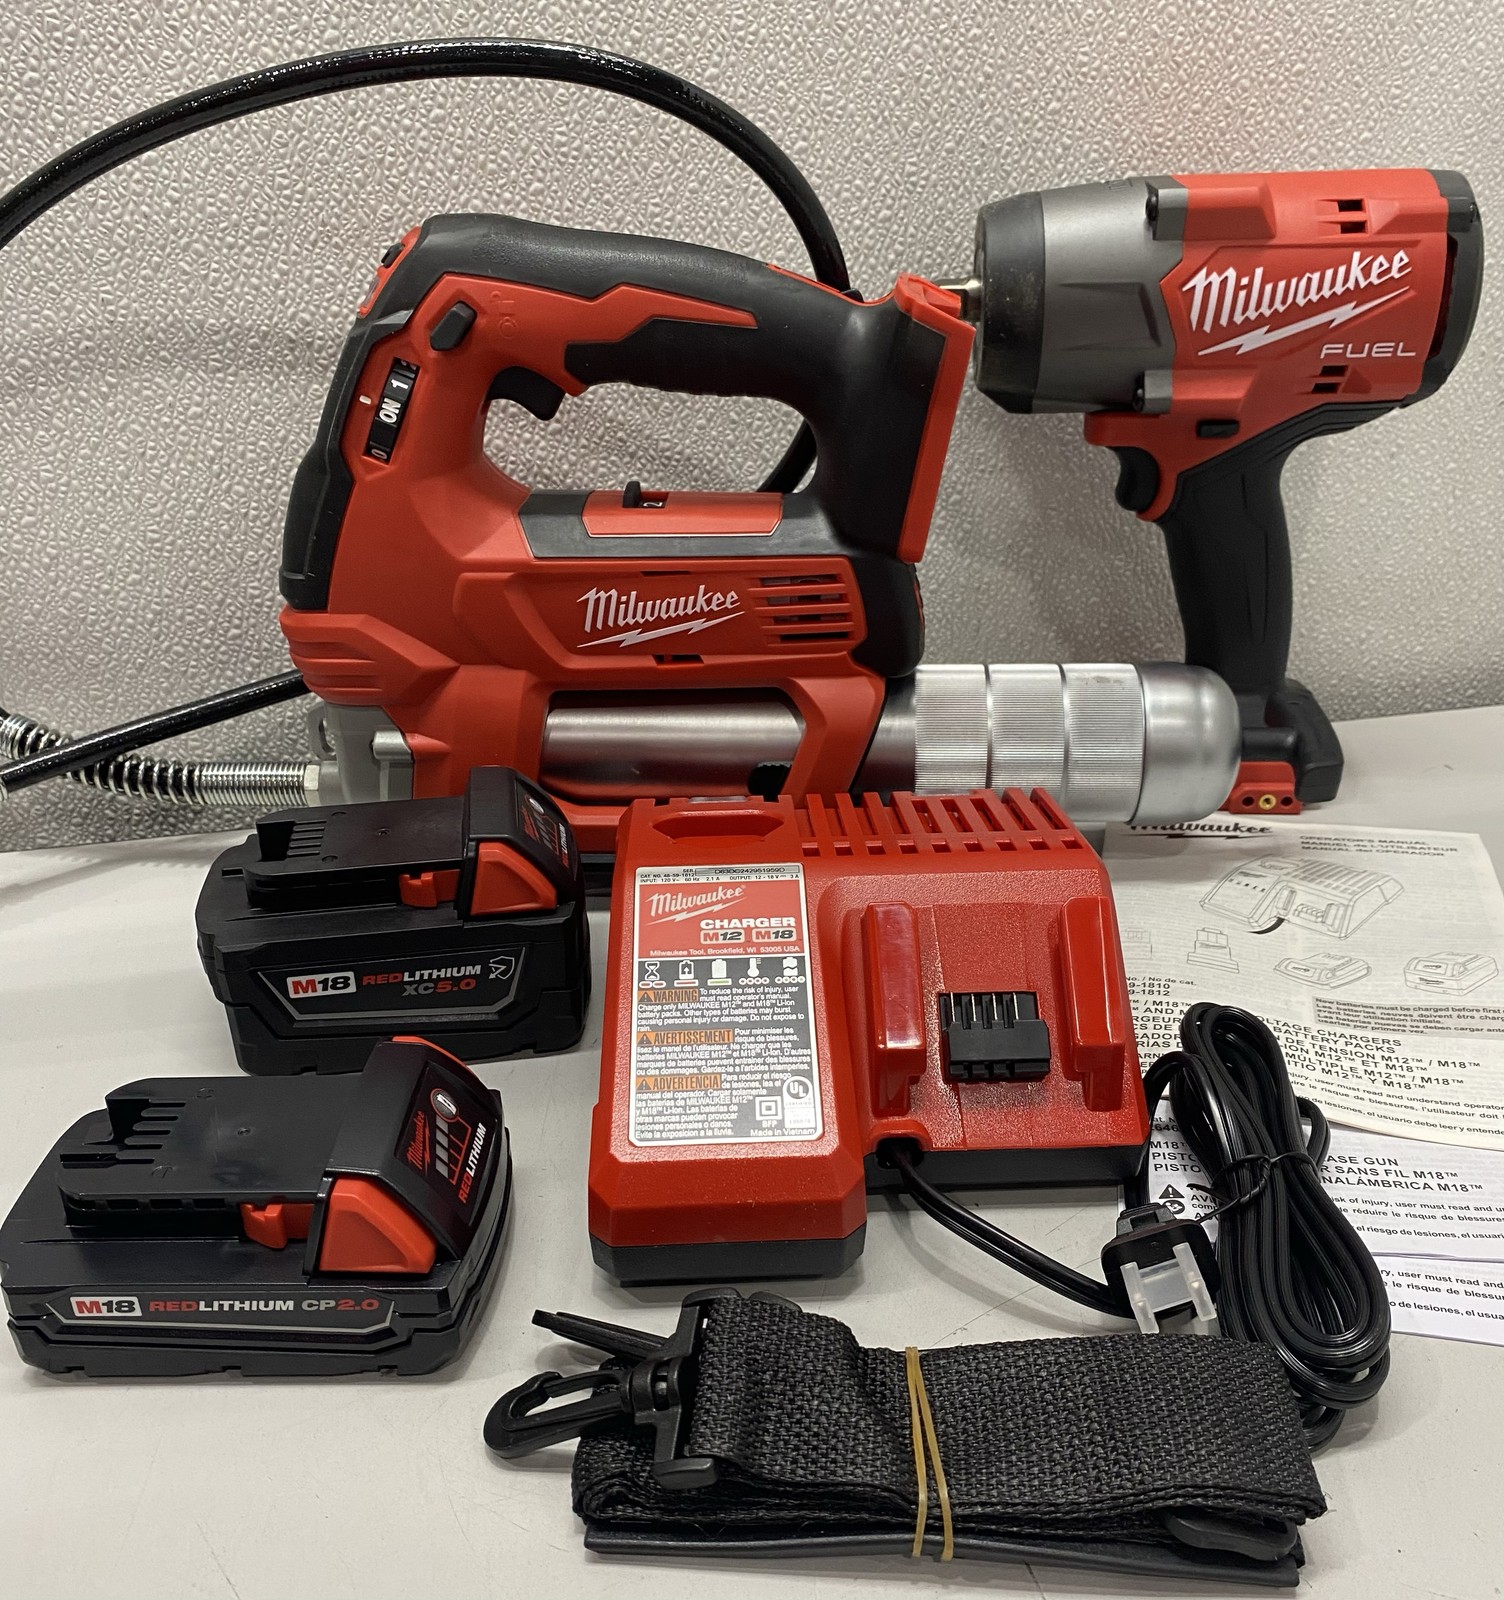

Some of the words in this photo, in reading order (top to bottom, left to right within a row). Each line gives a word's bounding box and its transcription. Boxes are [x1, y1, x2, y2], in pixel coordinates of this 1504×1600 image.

[1182, 250, 1412, 333] Milwaukee
[1320, 342, 1417, 360] FUEL
[391, 379, 409, 390] 1
[379, 398, 401, 424] ON
[576, 585, 741, 633] Milwaukee
[1131, 822, 1273, 833] waukee
[645, 886, 744, 917] Milwaukee
[700, 917, 796, 929] CHARGER
[703, 931, 742, 942] M12
[755, 930, 794, 940] M18
[292, 976, 351, 995] M18
[362, 965, 482, 985] REDLITHIUM
[402, 979, 477, 997] XC5.0
[653, 989, 698, 1002] WARNING
[709, 987, 731, 995] reduce
[1143, 1007, 1174, 1015] AND
[1413, 1006, 1450, 1014] charged
[654, 1029, 732, 1045] AVERTISSEMENT
[1256, 1016, 1312, 1033] OLTAGE
[1317, 1029, 1402, 1046] CHARGERS
[1273, 1026, 1339, 1045] BATTERY
[1345, 1041, 1395, 1054] PACKS
[1286, 1037, 1305, 1046] DE
[1309, 1042, 1375, 1060] TENSION
[1280, 1045, 1309, 1055] -ION
[1362, 1060, 1380, 1068] ET
[1287, 1060, 1316, 1071] ITIO
[653, 1075, 719, 1090] ADVERTENCIA
[790, 1082, 807, 1097] UL
[1314, 1078, 1335, 1086] user
[1337, 1084, 1361, 1092] must
[1363, 1089, 1384, 1097] read
[1386, 1092, 1404, 1100] and
[1406, 1097, 1461, 1107] understand
[1463, 1103, 1504, 1111] operator
[1321, 1088, 1350, 1098] risque
[1377, 1114, 1412, 1124] usuario
[1414, 1120, 1437, 1128] debe
[783, 1128, 815, 1136] Vietnam
[458, 1122, 487, 1203] REDLITHIUM
[1154, 1163, 1202, 1172] PISTO
[1364, 1157, 1399, 1166] GUN
[1334, 1165, 1380, 1176] SANS
[1384, 1169, 1410, 1178] FIL
[1320, 1176, 1434, 1191] NALÁMBRICA
[1361, 1197, 1393, 1207] injury,
[1352, 1207, 1388, 1217] réduire
[1404, 1212, 1437, 1221] risque
[1367, 1226, 1398, 1236] riesgo
[1414, 1229, 1460, 1239] lesiones,
[1398, 1271, 1421, 1279] user
[1425, 1274, 1453, 1283] must
[1456, 1278, 1480, 1286] read
[1407, 1283, 1441, 1292] risque
[75, 1300, 136, 1314] M18
[150, 1299, 295, 1312] REDLITHIUM
[301, 1299, 379, 1312] CP2.0
[1414, 1302, 1463, 1316] lesiones,
[1465, 1309, 1475, 1317] el
